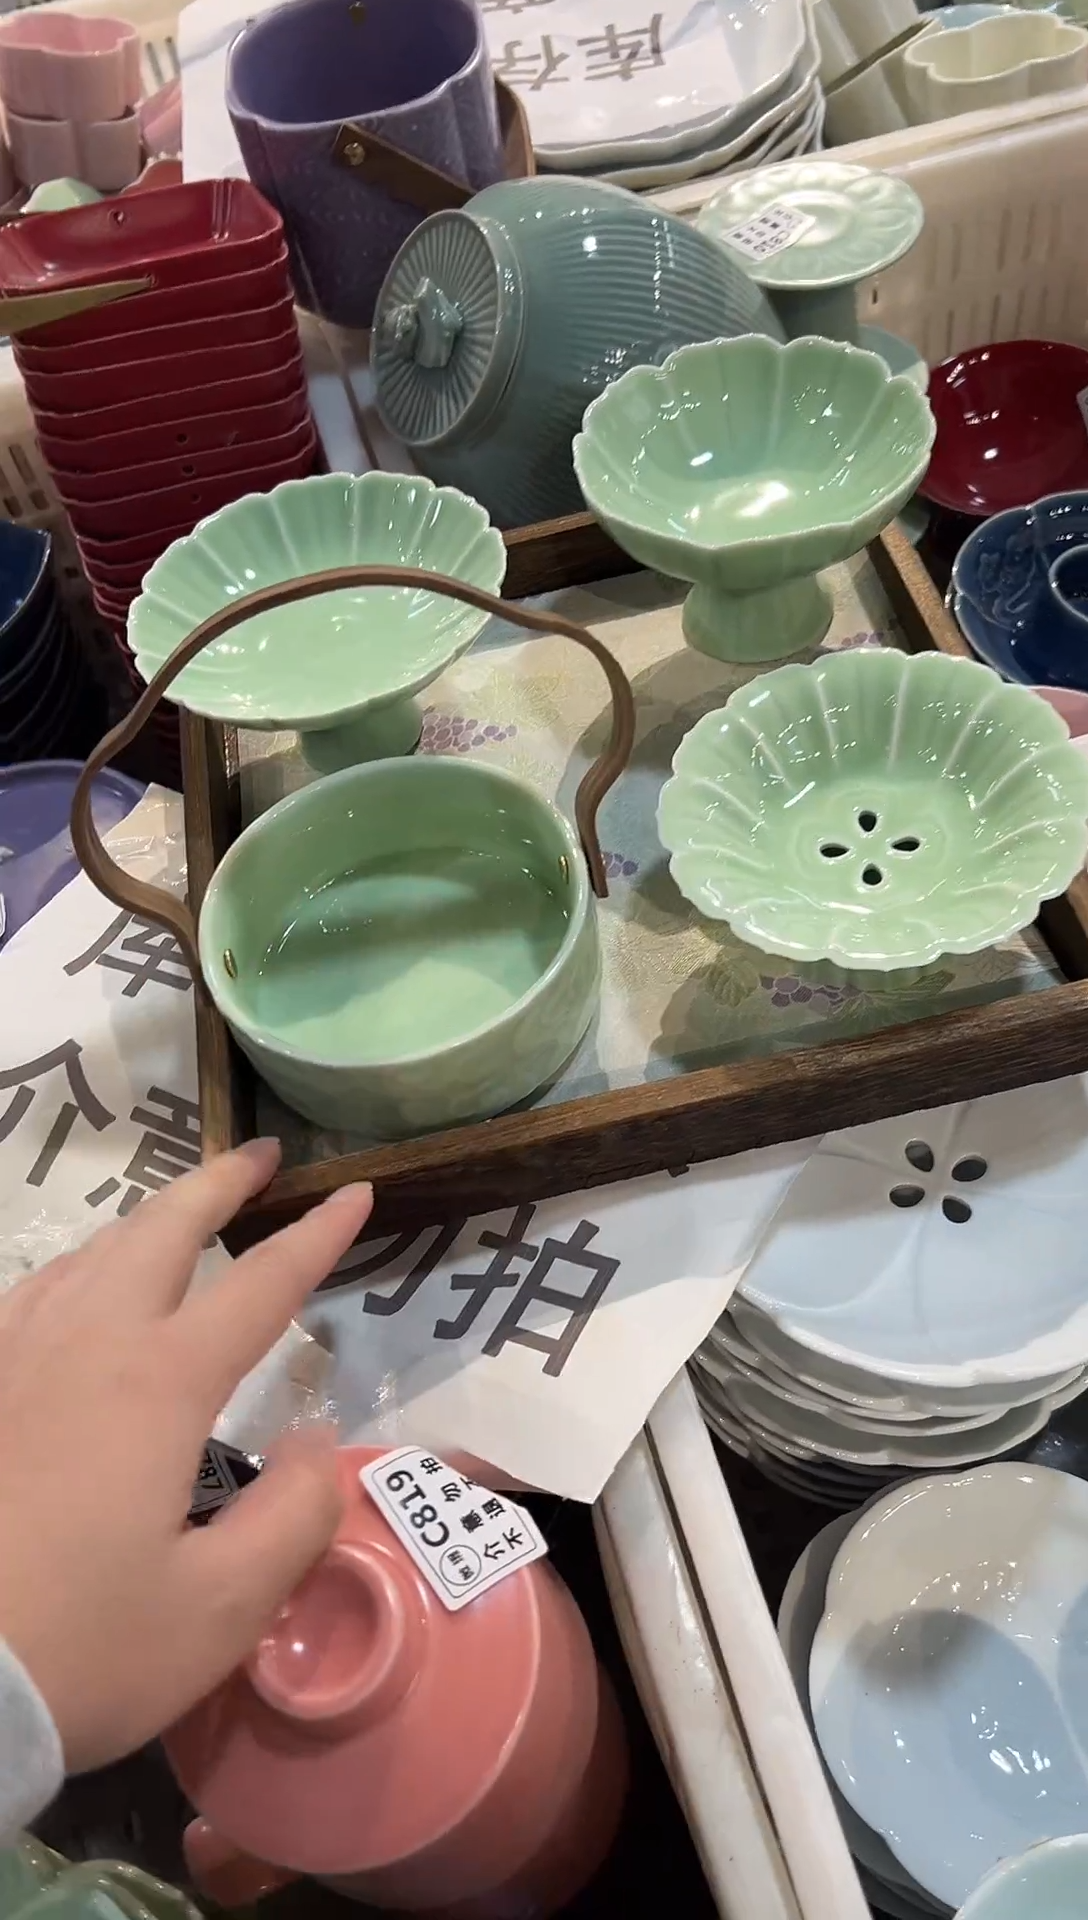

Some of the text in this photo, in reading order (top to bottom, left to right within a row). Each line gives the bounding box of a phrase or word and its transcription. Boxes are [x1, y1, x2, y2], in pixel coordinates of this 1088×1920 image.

[491, 13, 665, 91] 库存
[386, 1470, 450, 1547] C819
[420, 1457, 506, 1560] 介意勿拍
